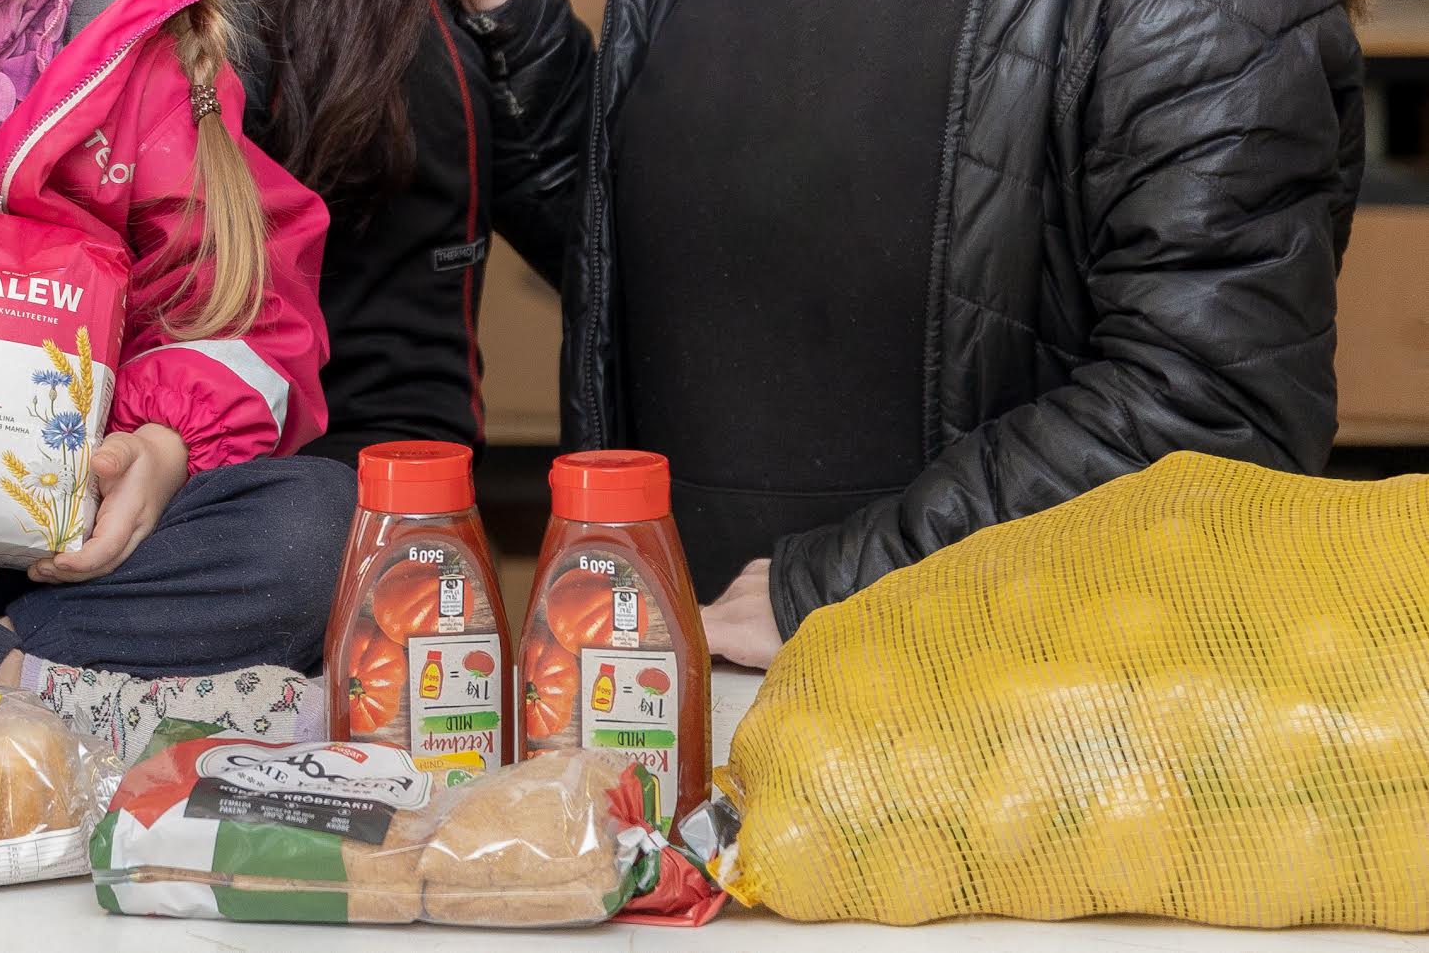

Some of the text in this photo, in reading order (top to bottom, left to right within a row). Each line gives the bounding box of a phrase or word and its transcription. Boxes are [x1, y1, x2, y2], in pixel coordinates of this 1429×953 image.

[446, 715, 473, 731] MILD
[420, 730, 494, 754] Ketchup
[617, 731, 646, 747] MILD
